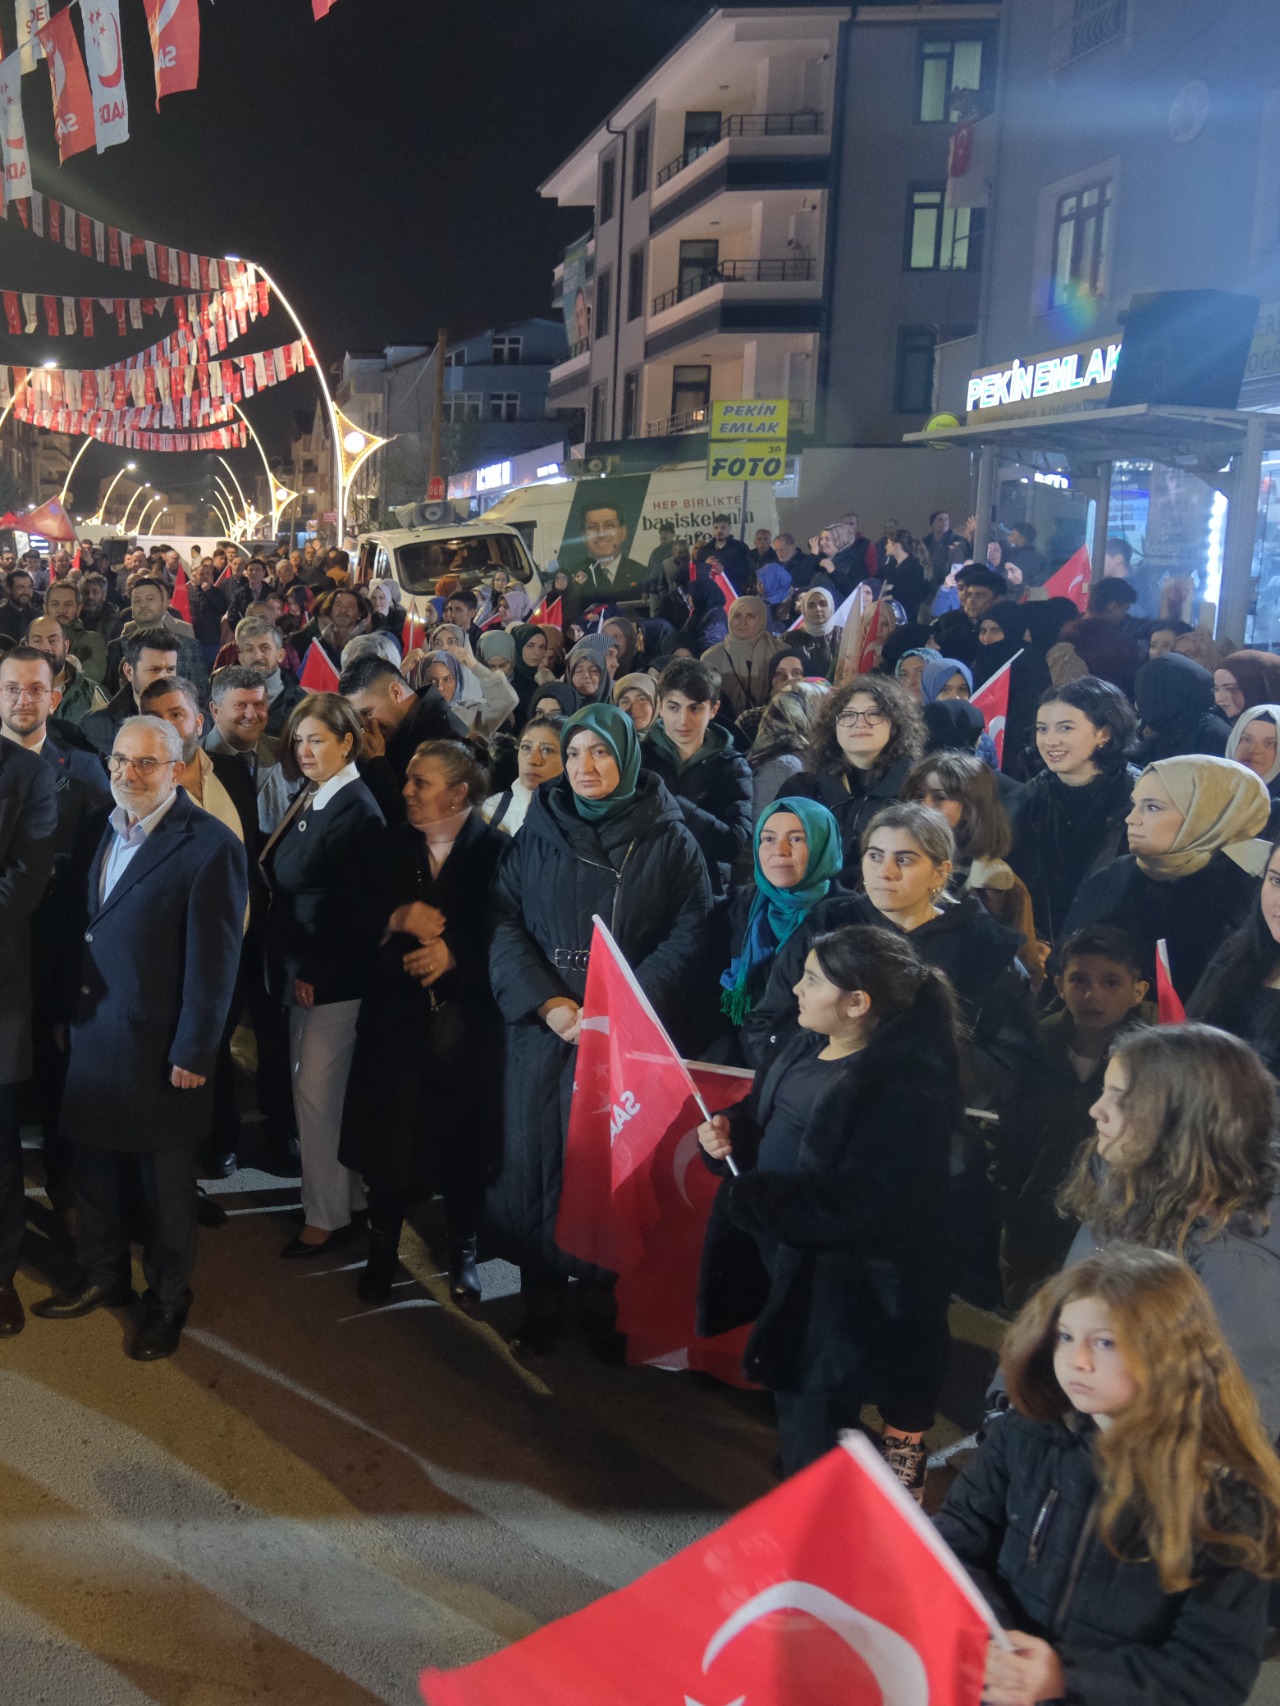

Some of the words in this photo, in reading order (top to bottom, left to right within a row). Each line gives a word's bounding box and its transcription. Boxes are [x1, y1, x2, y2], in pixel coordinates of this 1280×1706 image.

[966, 358, 1035, 412] PEKİN
[1033, 343, 1122, 398] EMLAK
[723, 402, 777, 416] PEKİN
[719, 421, 779, 433] EMLAK
[711, 457, 782, 477] FOTO
[653, 500, 678, 510] HEP
[683, 495, 742, 509] BİRLİKTE
